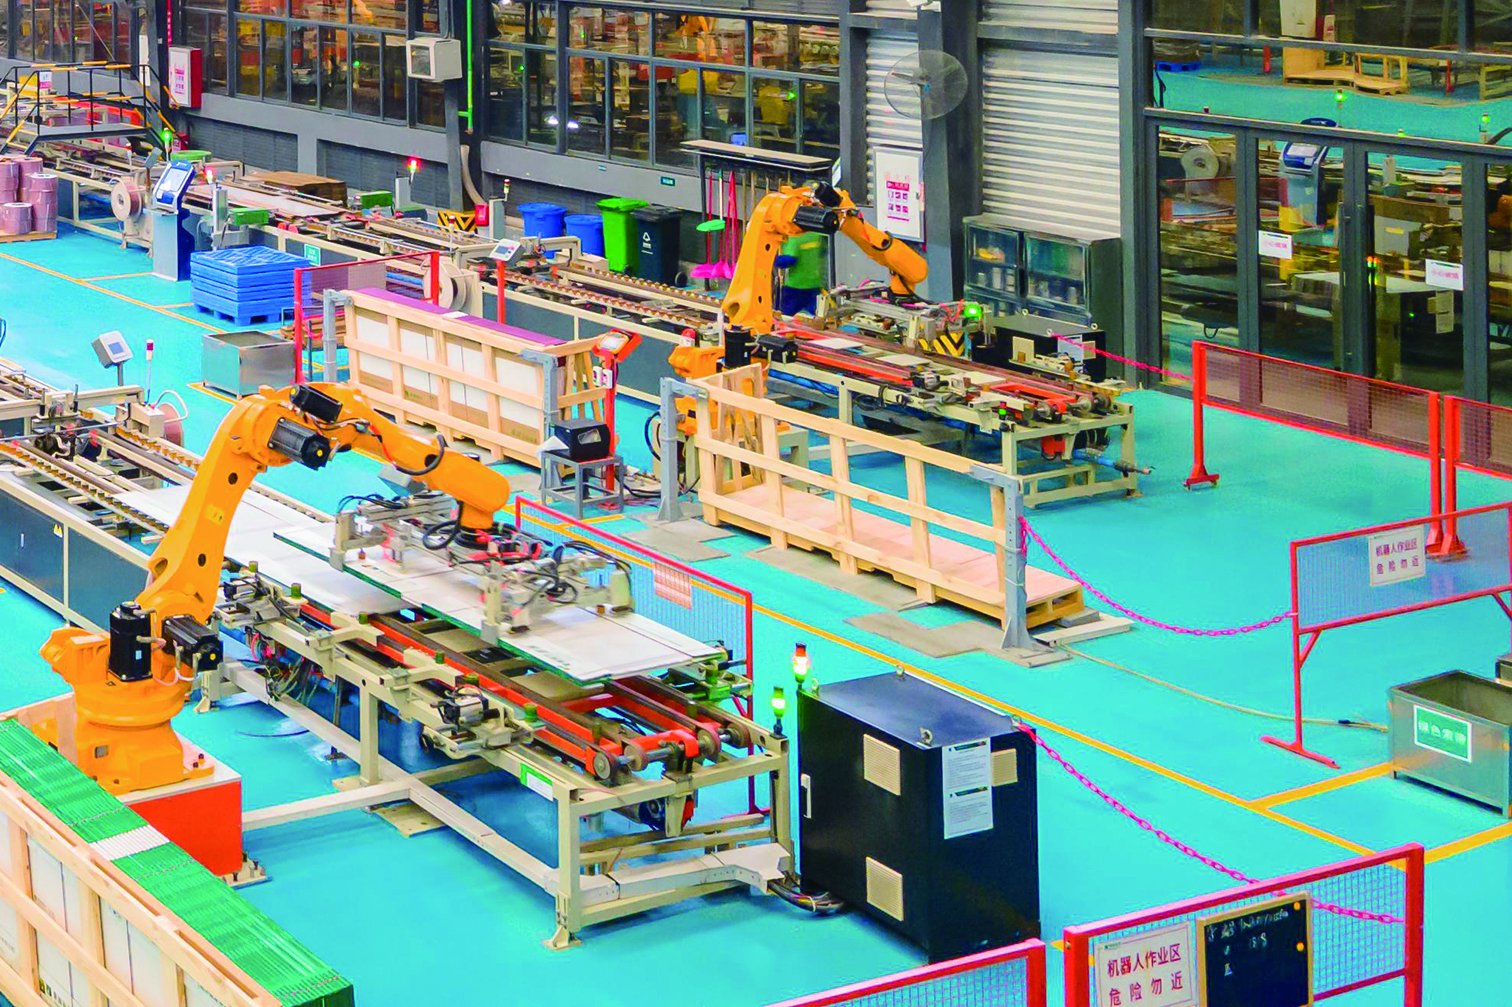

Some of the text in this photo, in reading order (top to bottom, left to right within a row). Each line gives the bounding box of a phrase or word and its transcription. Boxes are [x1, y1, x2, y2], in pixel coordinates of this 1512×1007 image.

[1376, 538, 1418, 557] 机器人作业区
[1107, 943, 1181, 978] 机器人作业区
[1108, 971, 1183, 1007] 危险勿近
